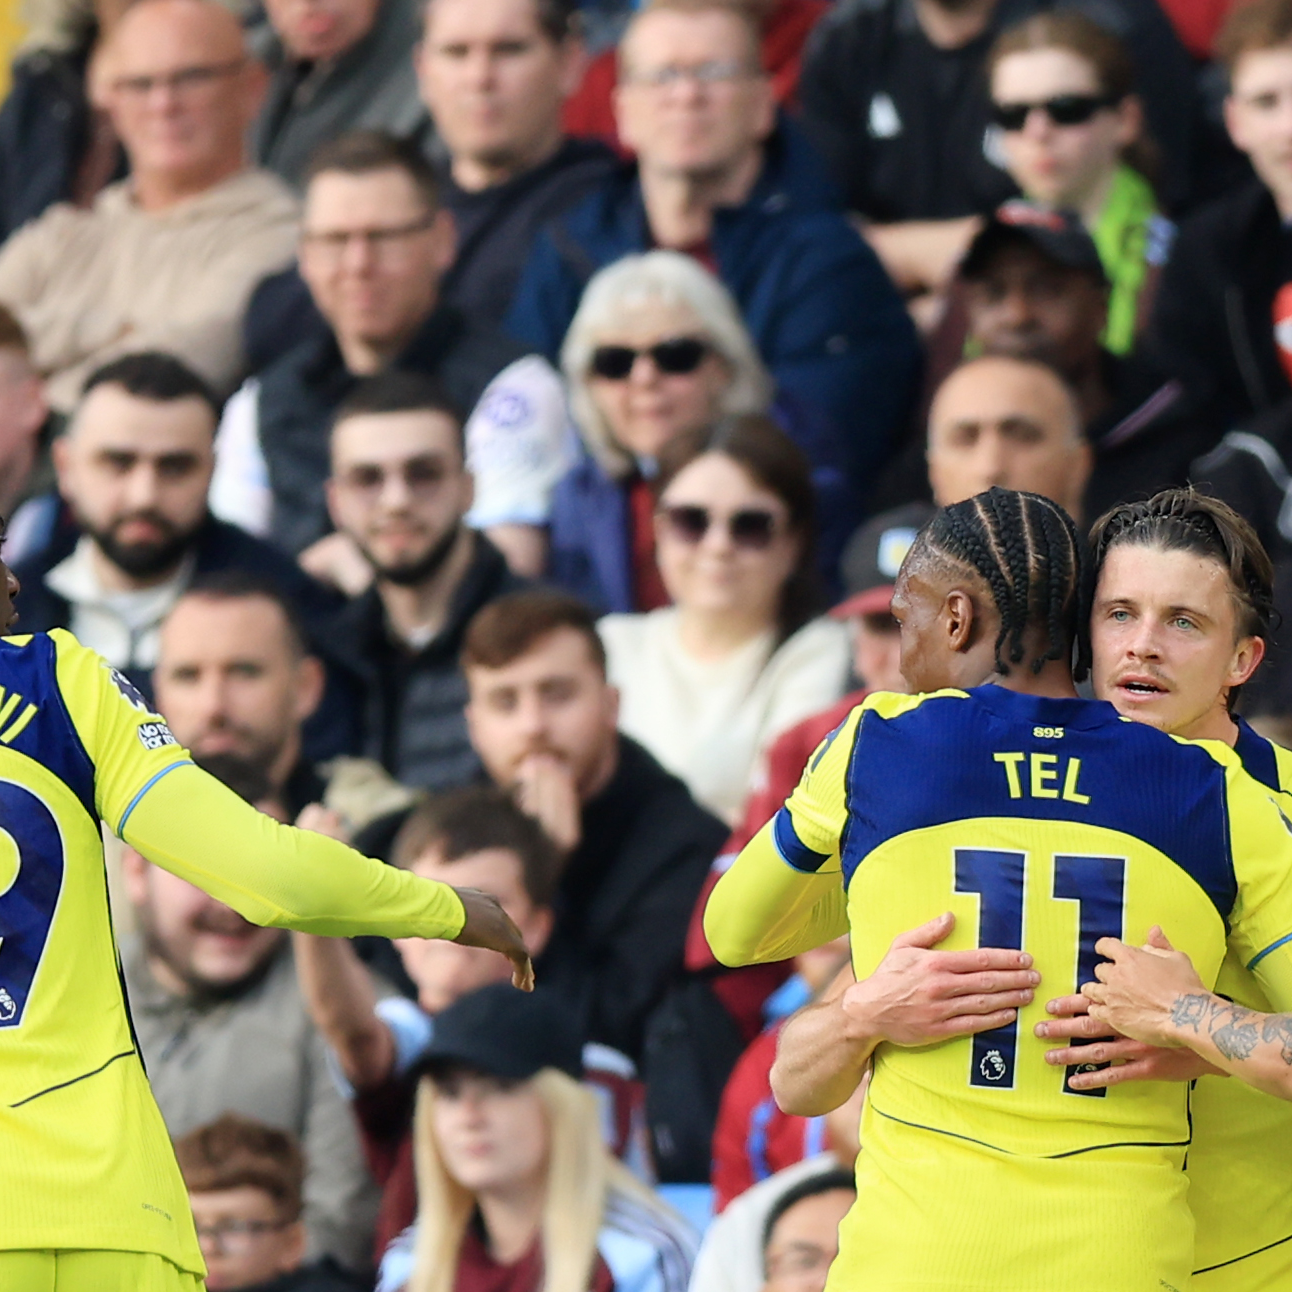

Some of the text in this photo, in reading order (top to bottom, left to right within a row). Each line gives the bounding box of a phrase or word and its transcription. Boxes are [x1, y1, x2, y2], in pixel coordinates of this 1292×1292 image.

[1032, 726, 1065, 739] 895
[993, 752, 1091, 806] TEL
[952, 847, 1129, 1097] 11
